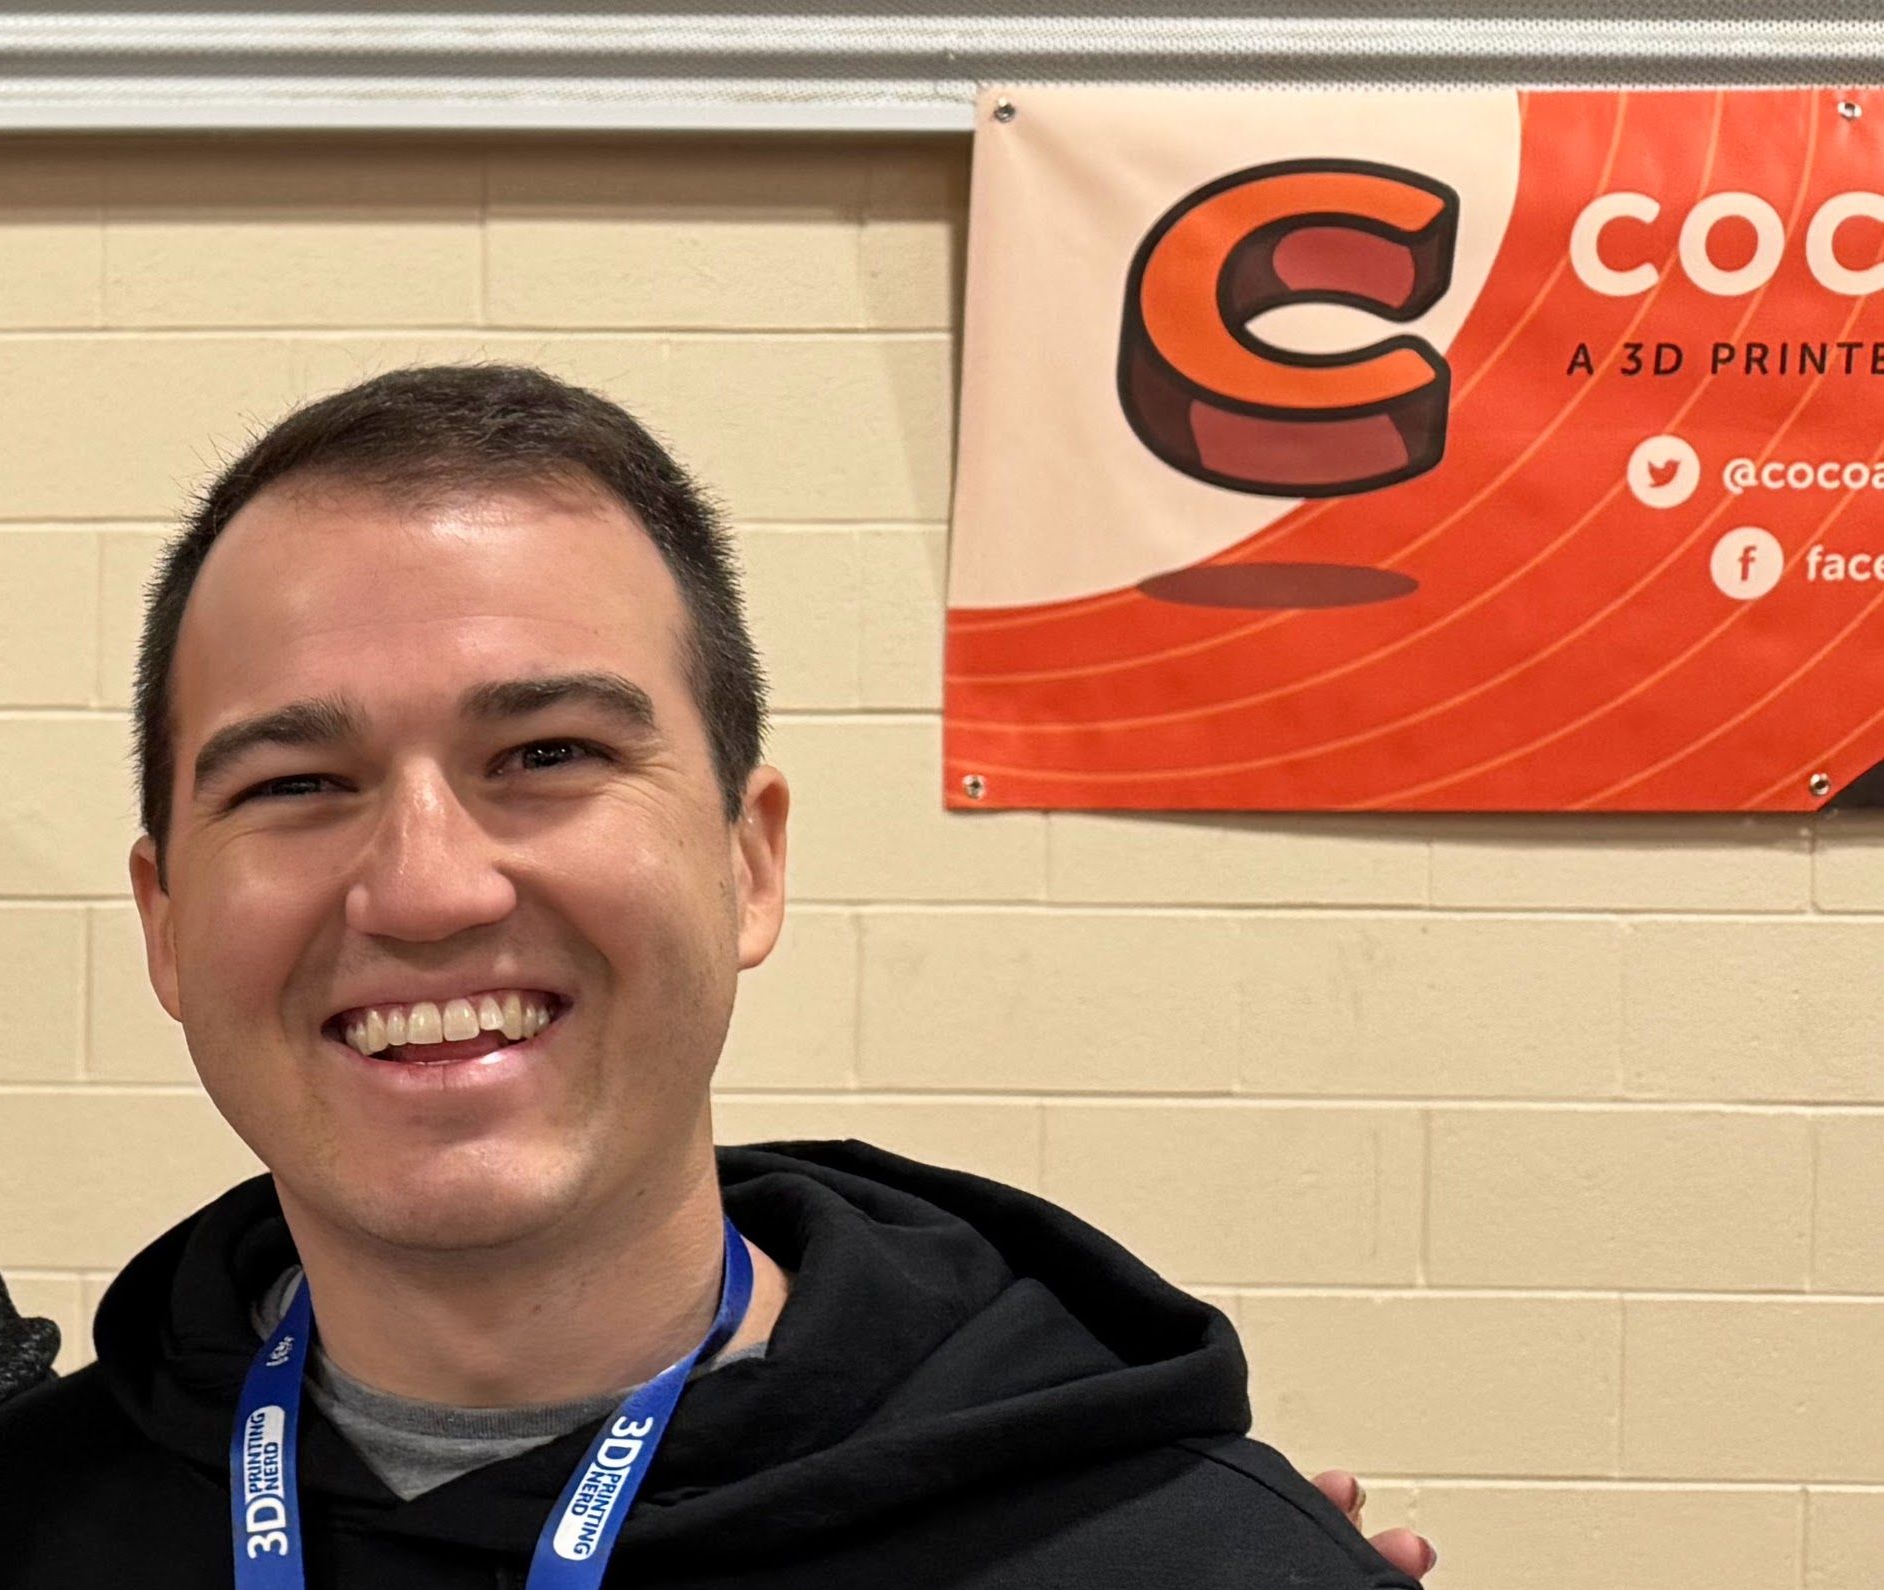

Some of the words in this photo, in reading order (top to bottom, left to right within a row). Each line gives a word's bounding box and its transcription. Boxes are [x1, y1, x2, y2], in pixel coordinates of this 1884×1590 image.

[1566, 342, 1595, 377] A
[1621, 342, 1684, 377] 3D
[248, 1411, 267, 1494] PRINTING
[263, 1441, 281, 1492] NERD
[597, 1415, 653, 1471] 3D
[570, 1462, 611, 1517] NERD
[573, 1470, 622, 1557] PRINTING
[246, 1496, 290, 1560] 3D
